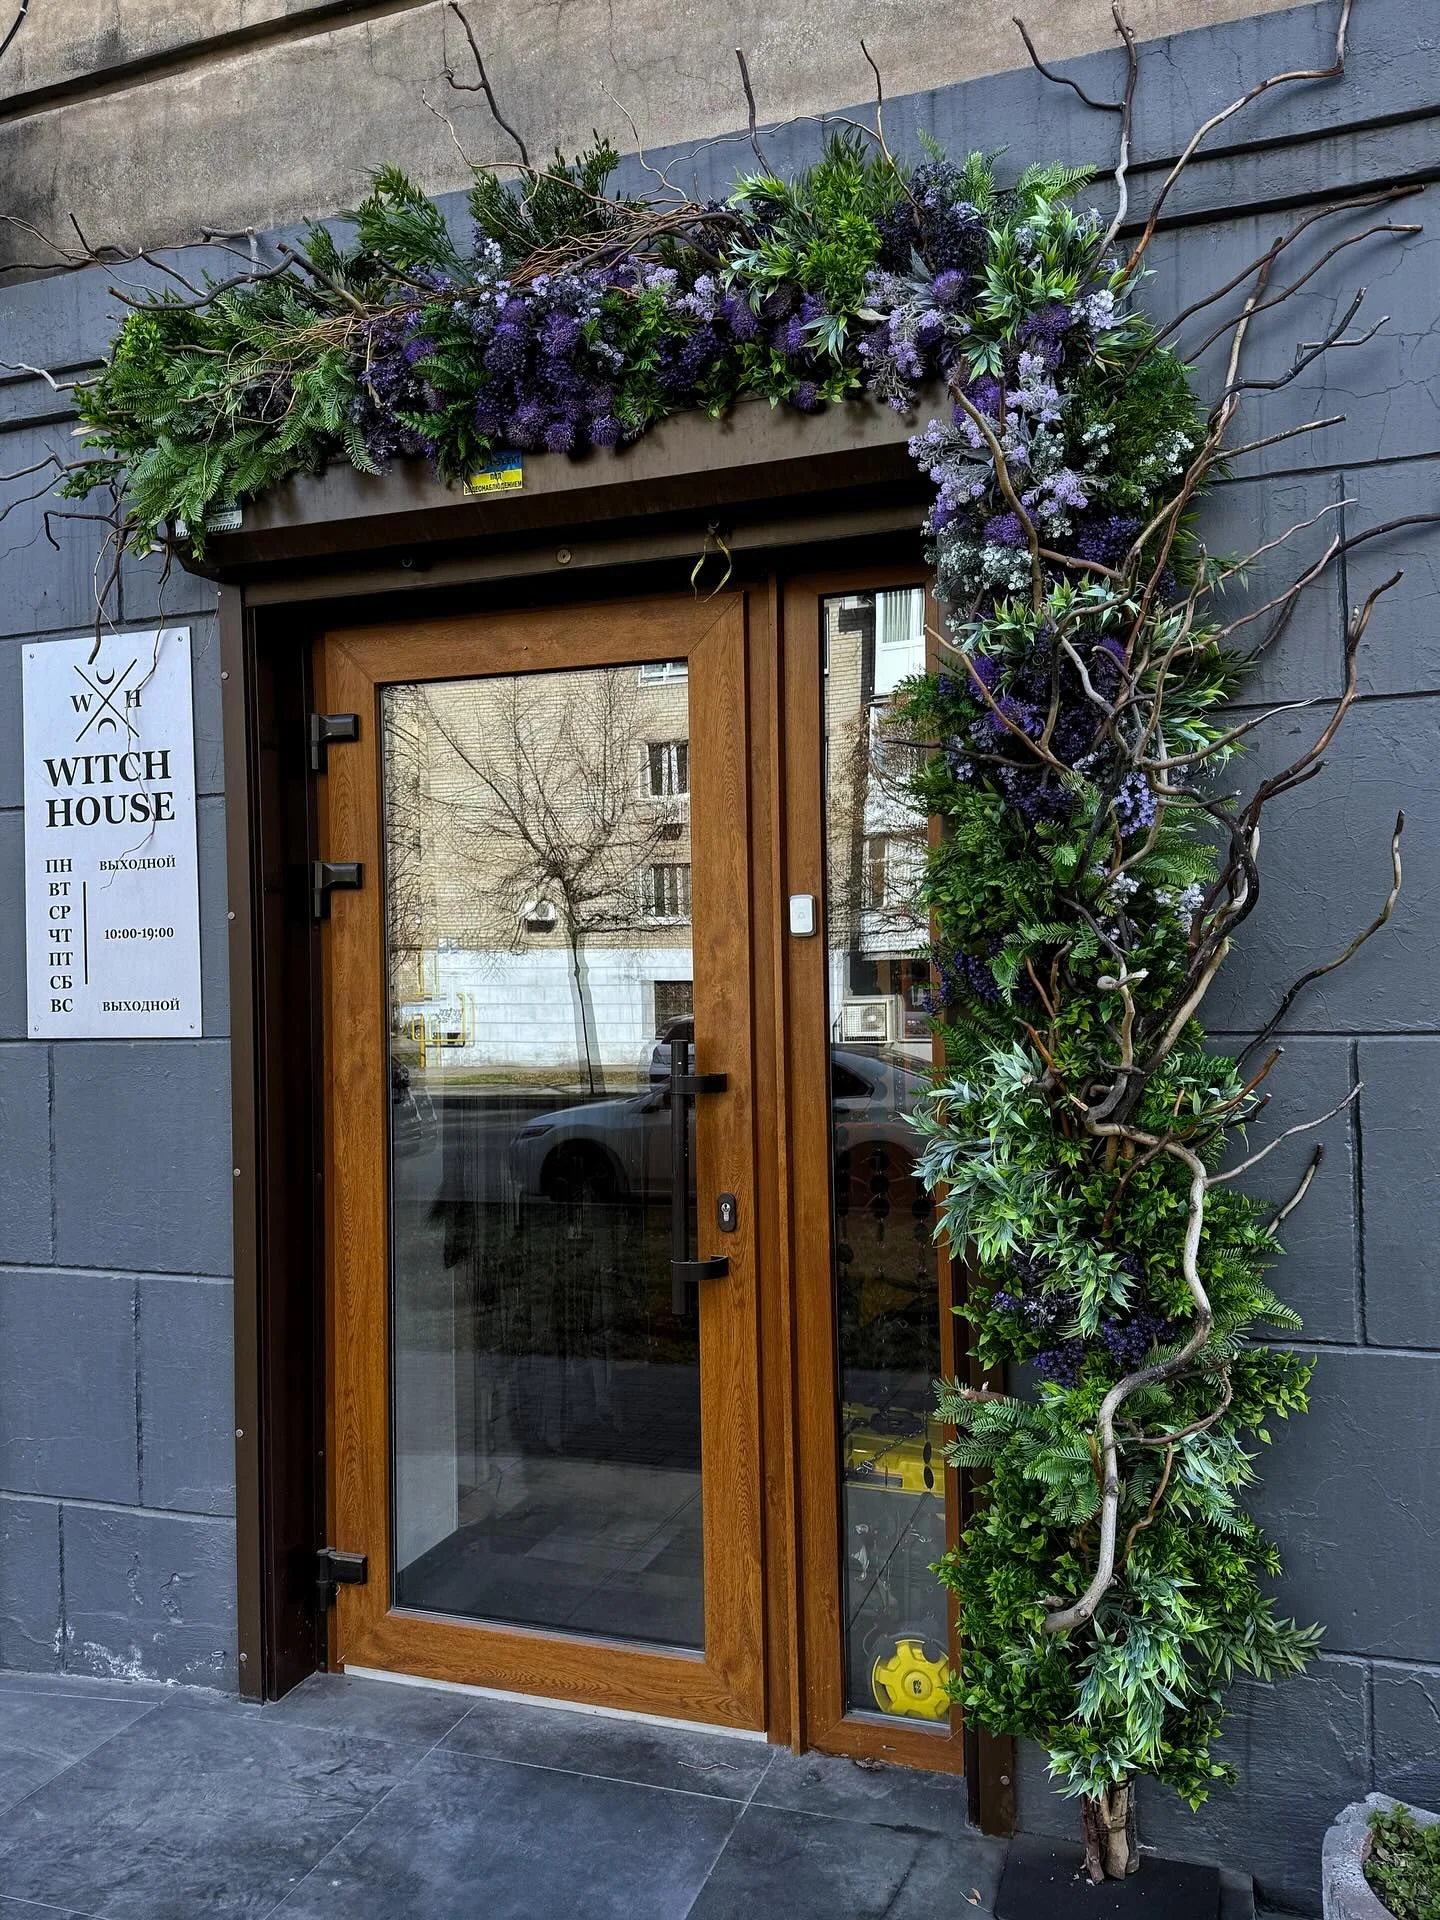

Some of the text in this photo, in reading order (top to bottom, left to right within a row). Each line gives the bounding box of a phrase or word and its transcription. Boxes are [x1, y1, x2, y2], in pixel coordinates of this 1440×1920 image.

[70, 689, 142, 713] W H
[43, 749, 172, 787] WITCH
[45, 791, 175, 828] HOUSE
[45, 858, 73, 874] ПН
[48, 881, 71, 897] ВТ
[49, 905, 71, 920] СР
[48, 926, 174, 943] ЧТ 10:00-19:00
[48, 951, 74, 967] ПТ
[49, 975, 73, 990] СБ
[50, 998, 74, 1013] ВС
